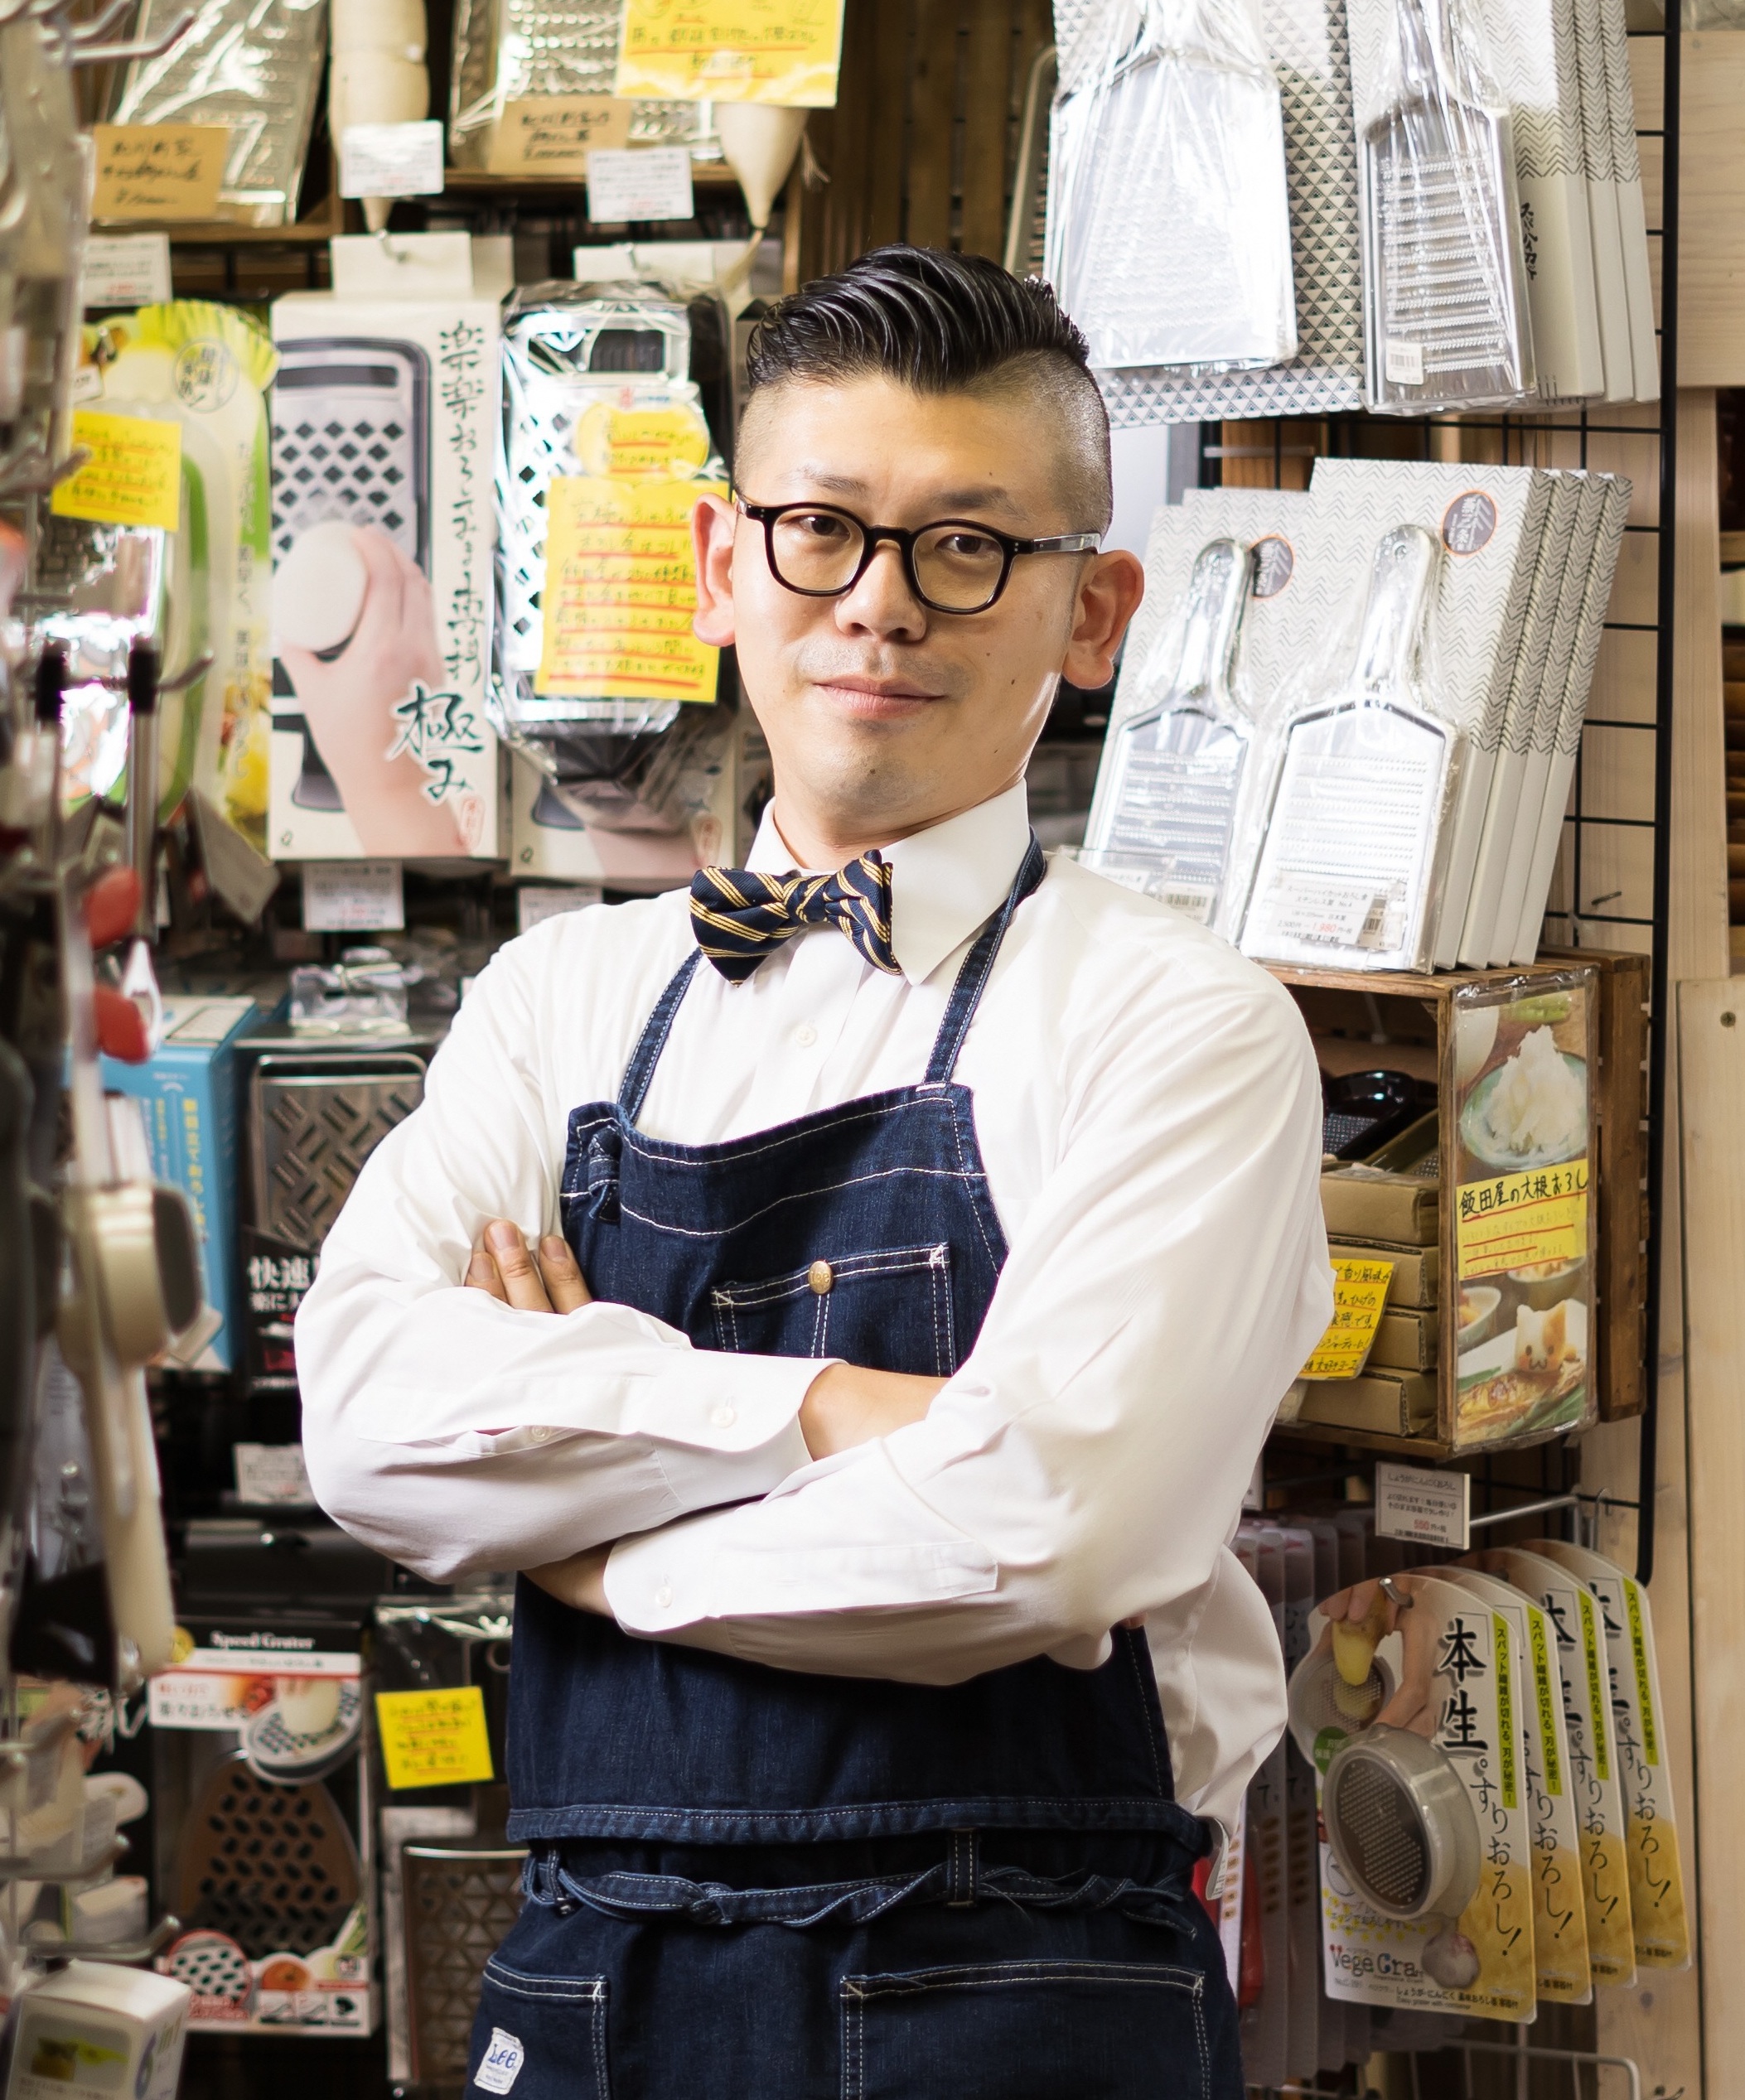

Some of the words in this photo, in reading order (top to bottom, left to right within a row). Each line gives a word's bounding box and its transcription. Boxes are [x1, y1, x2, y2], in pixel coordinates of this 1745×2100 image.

[1459, 1168, 1588, 1219] 飯田屋の大根おろし
[248, 1254, 321, 1291] 快速
[210, 1630, 259, 1649] Speed
[260, 1632, 315, 1649] Grater
[487, 2043, 518, 2069] Lee
